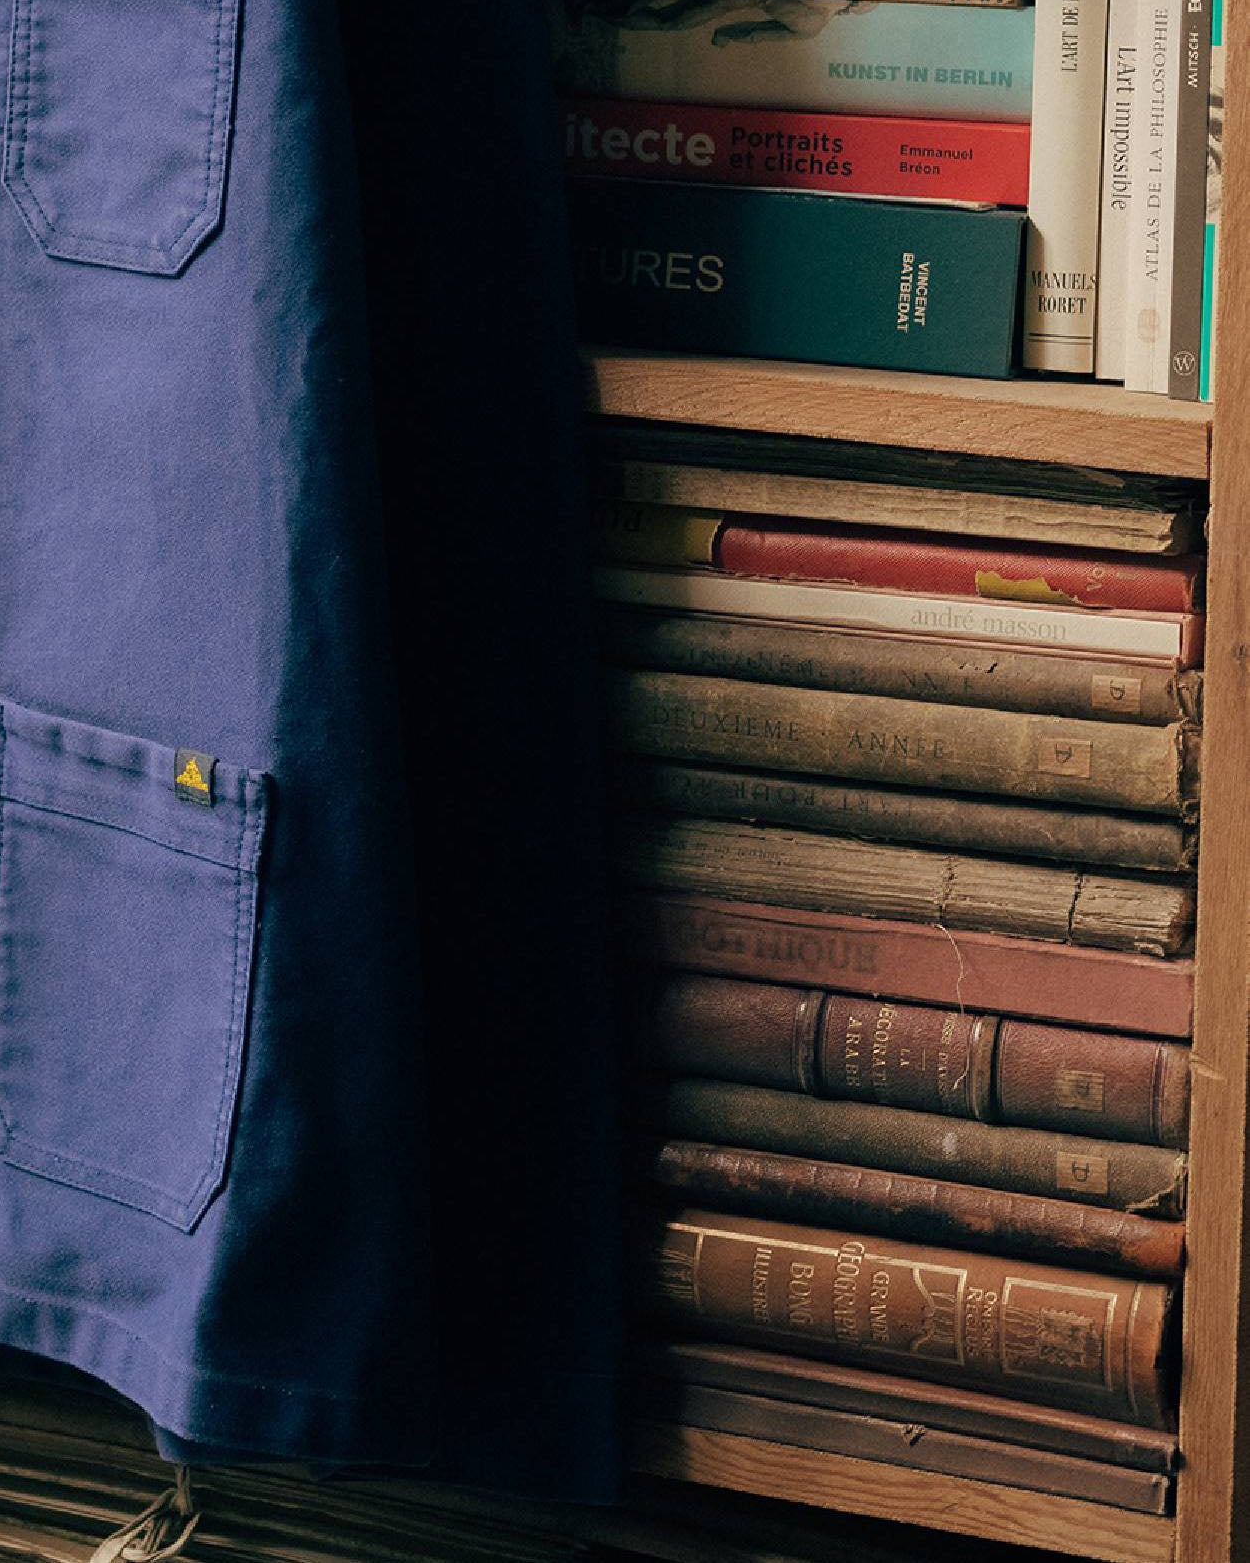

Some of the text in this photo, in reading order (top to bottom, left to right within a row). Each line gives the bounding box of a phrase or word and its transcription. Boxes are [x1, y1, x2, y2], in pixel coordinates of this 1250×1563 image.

[1062, 6, 1079, 26] DE
[1061, 30, 1078, 74] L'ART
[828, 62, 1014, 88] KUNST IN BERLIN
[731, 126, 844, 154] Portraits
[899, 143, 974, 161] Emmanuel
[1111, 45, 1138, 211] L'Art impossible
[729, 151, 941, 178] et clichés Bréon
[1148, 147, 1163, 173] LA
[1147, 183, 1162, 209] DE
[1146, 218, 1161, 281] ATLAS
[896, 252, 916, 334] BATBEDAT
[914, 261, 931, 327] VINCENT
[1031, 270, 1098, 291] MANUELS
[1037, 294, 1087, 315] RORET
[910, 606, 1067, 641] andré masson
